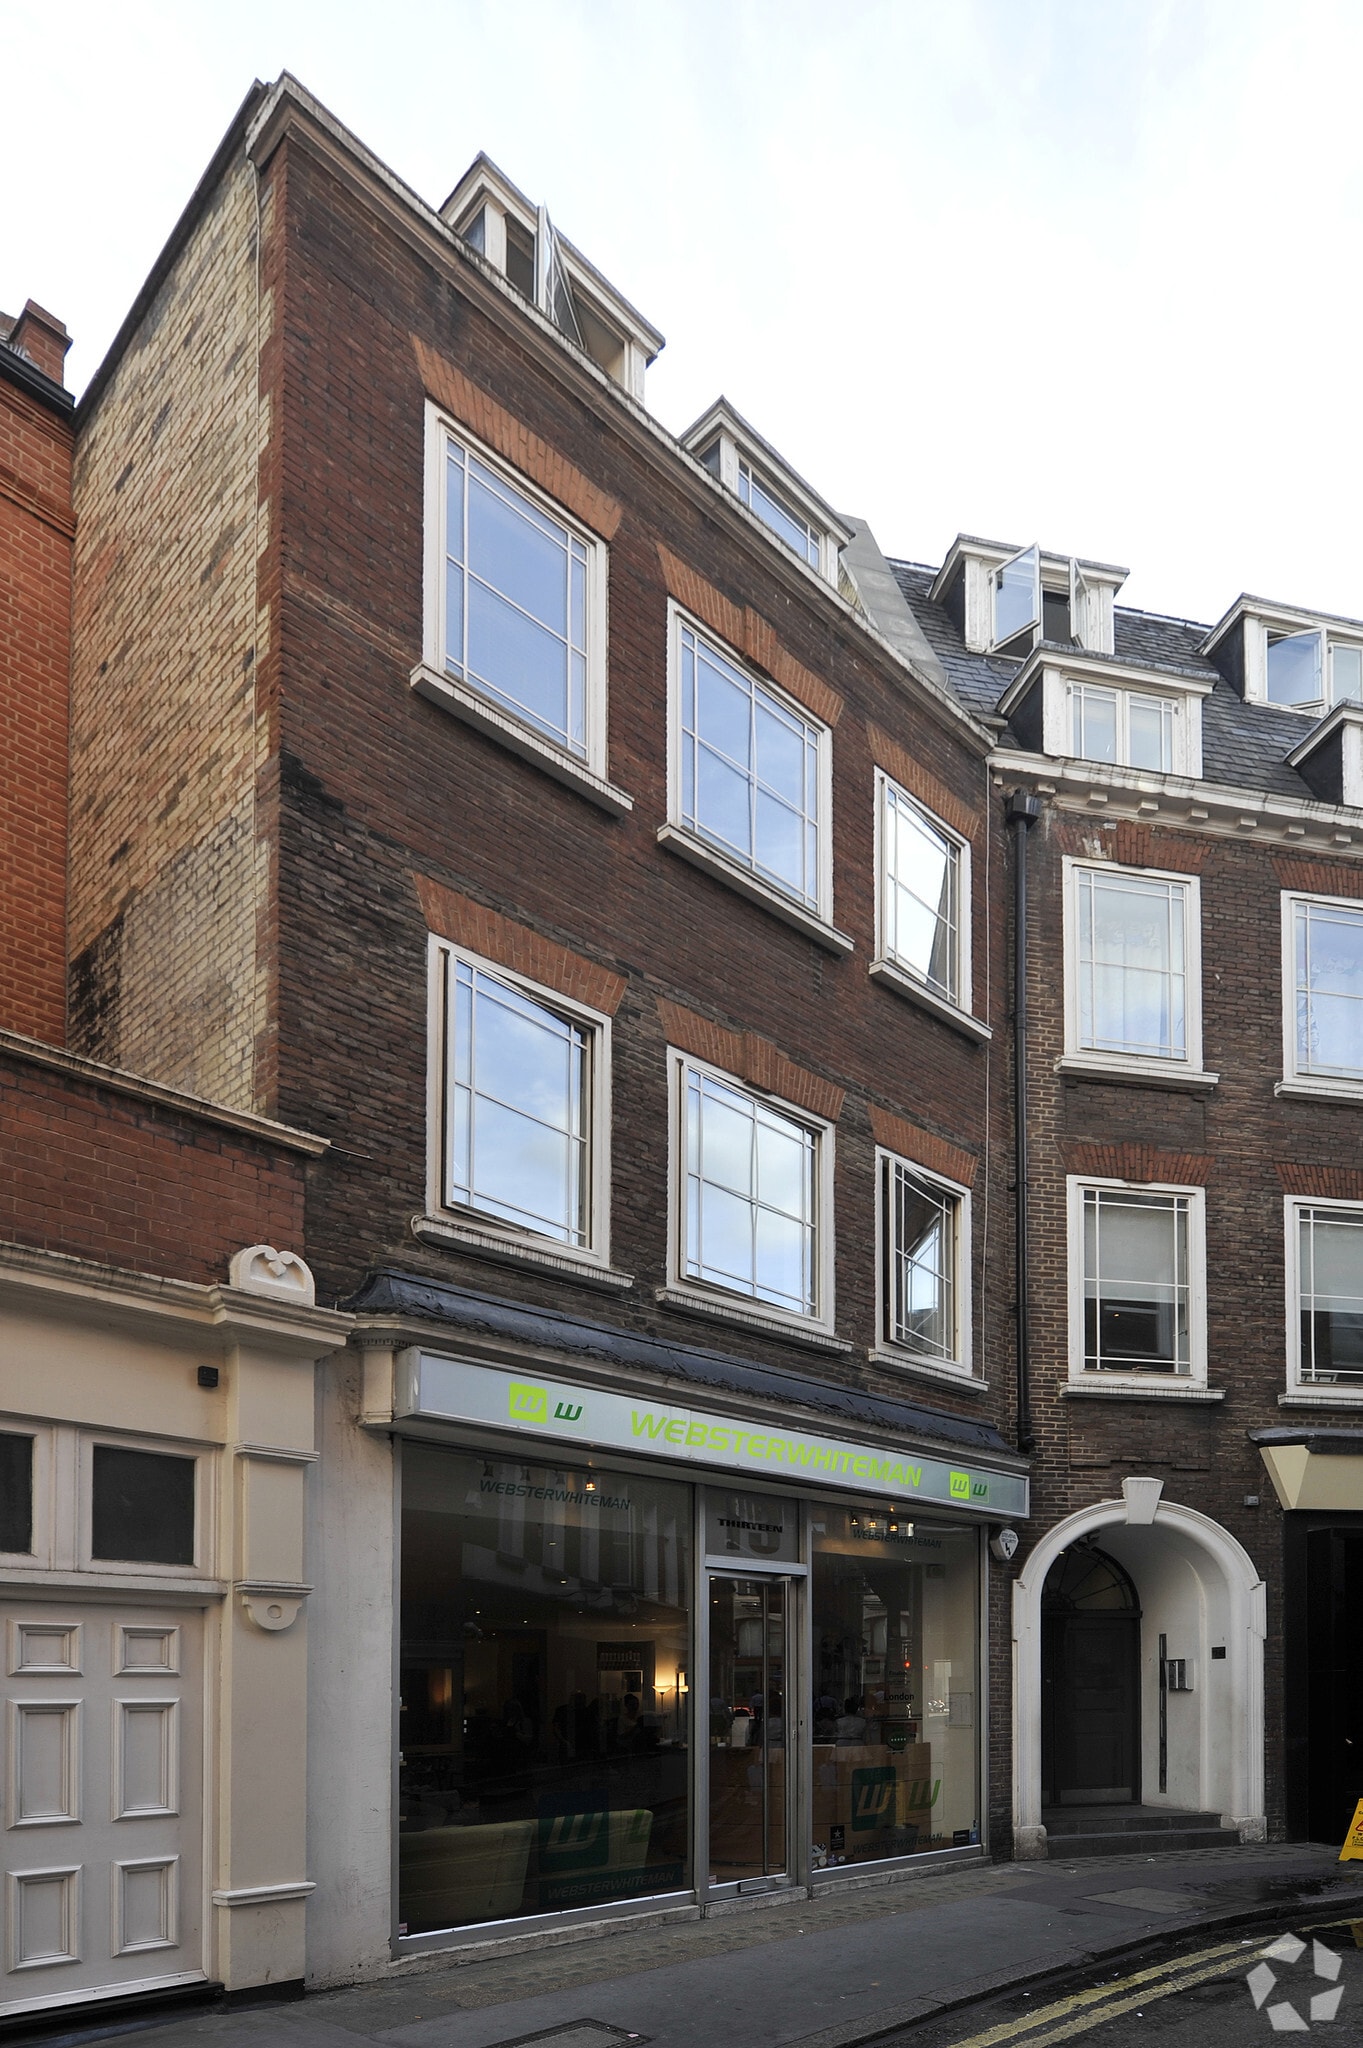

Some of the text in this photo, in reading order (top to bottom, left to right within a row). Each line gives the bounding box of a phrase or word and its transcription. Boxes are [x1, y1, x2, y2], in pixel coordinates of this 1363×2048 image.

[631, 1410, 922, 1487] WEBSTERWHITEMAN
[480, 1479, 631, 1510] WEBSTERWHITEMAN
[717, 1518, 783, 1534] THIRTEEN
[853, 1528, 942, 1549] WEBSTERWHITEMAN
[884, 1692, 915, 1701] London
[854, 1833, 942, 1853] WEBSTERWHITEMAN
[548, 1872, 674, 1899] WEBSTERWHITEMAN
